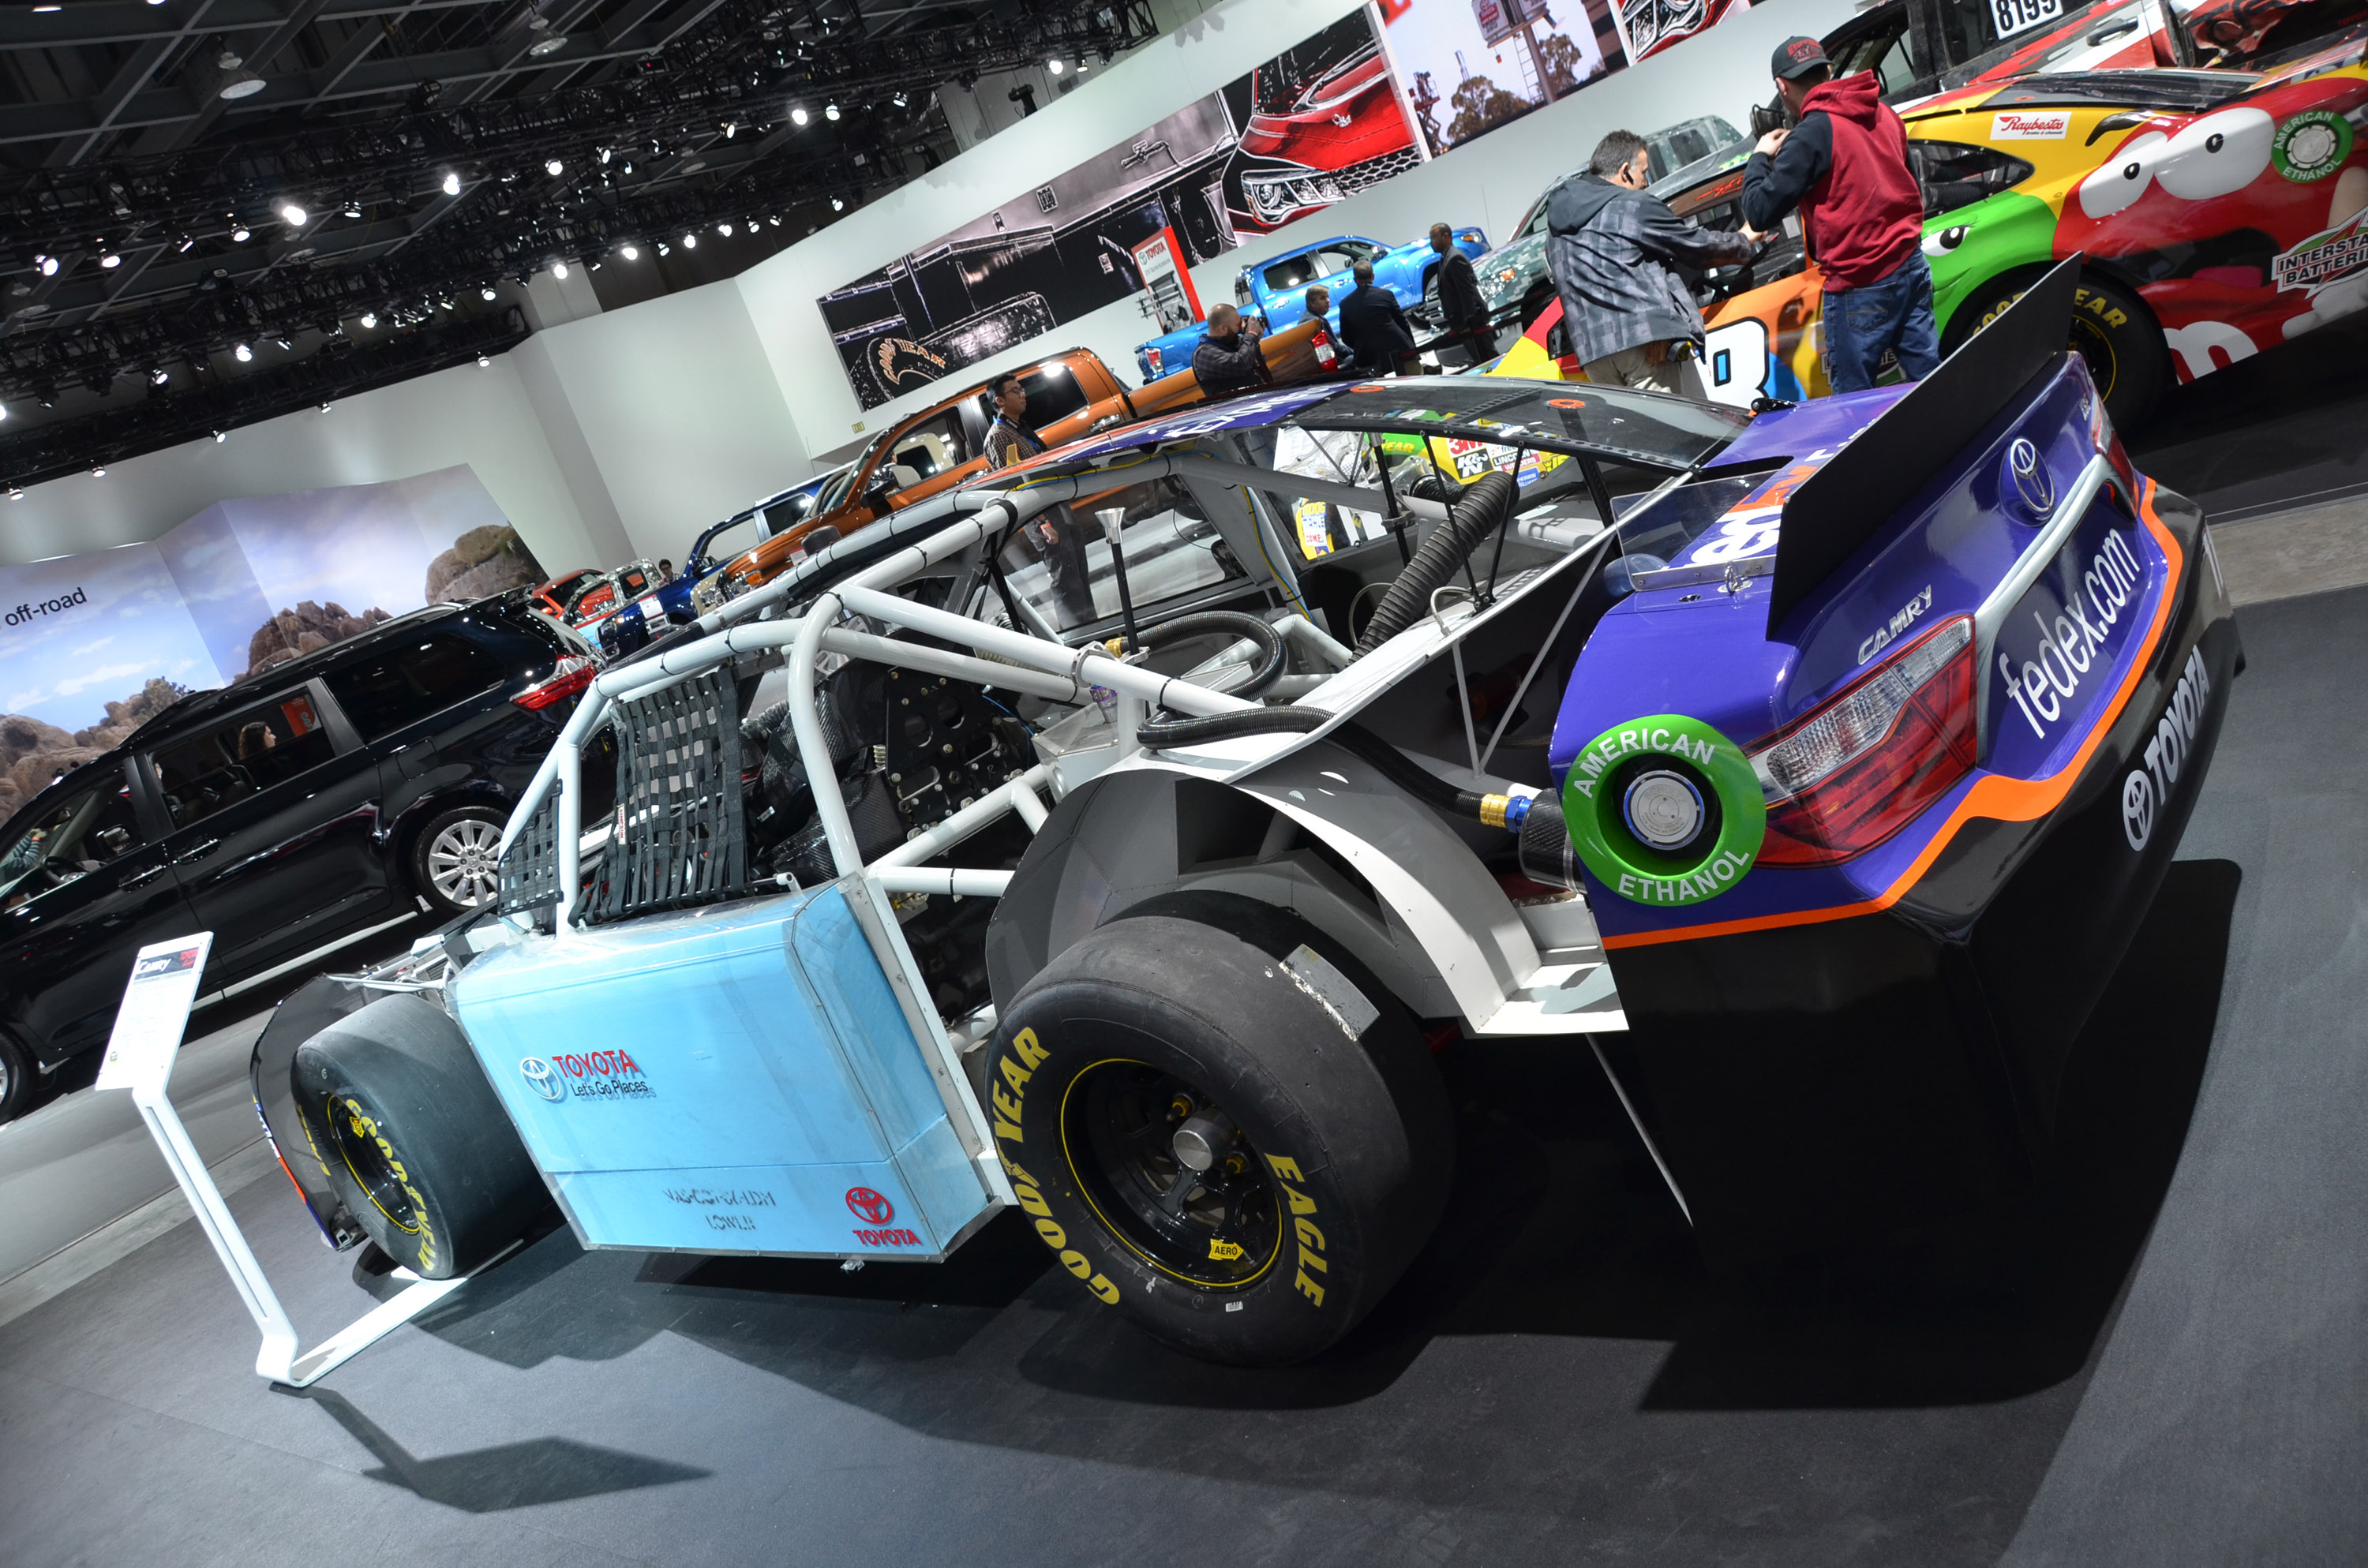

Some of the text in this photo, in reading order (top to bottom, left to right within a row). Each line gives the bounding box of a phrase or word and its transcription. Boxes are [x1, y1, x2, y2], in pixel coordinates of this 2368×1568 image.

[1999, 116, 2064, 135] Raybestos
[2273, 111, 2334, 149] AMERICAN
[2283, 159, 2342, 181] ETHANOL
[1145, 241, 1167, 260] TOYOTA
[2285, 247, 2368, 283] BATTERI
[2074, 289, 2127, 328] EAR
[6, 587, 87, 626] off-road
[1858, 584, 1931, 665] CAMRY
[1999, 528, 2140, 739] fedex.com
[2144, 644, 2210, 806] TOYOTA
[1574, 728, 1714, 798] AMERICAN
[1618, 850, 1750, 901] ETHANOL
[552, 1049, 639, 1078] TOYOTA
[570, 1080, 648, 1096] Let's Go Places
[347, 1099, 408, 1183] GOOD
[994, 1027, 1120, 1306] GOOD YEAR
[852, 1229, 922, 1245] TOYOTA
[1265, 1152, 1328, 1307] EAGLE
[1215, 1245, 1238, 1256] AERO
